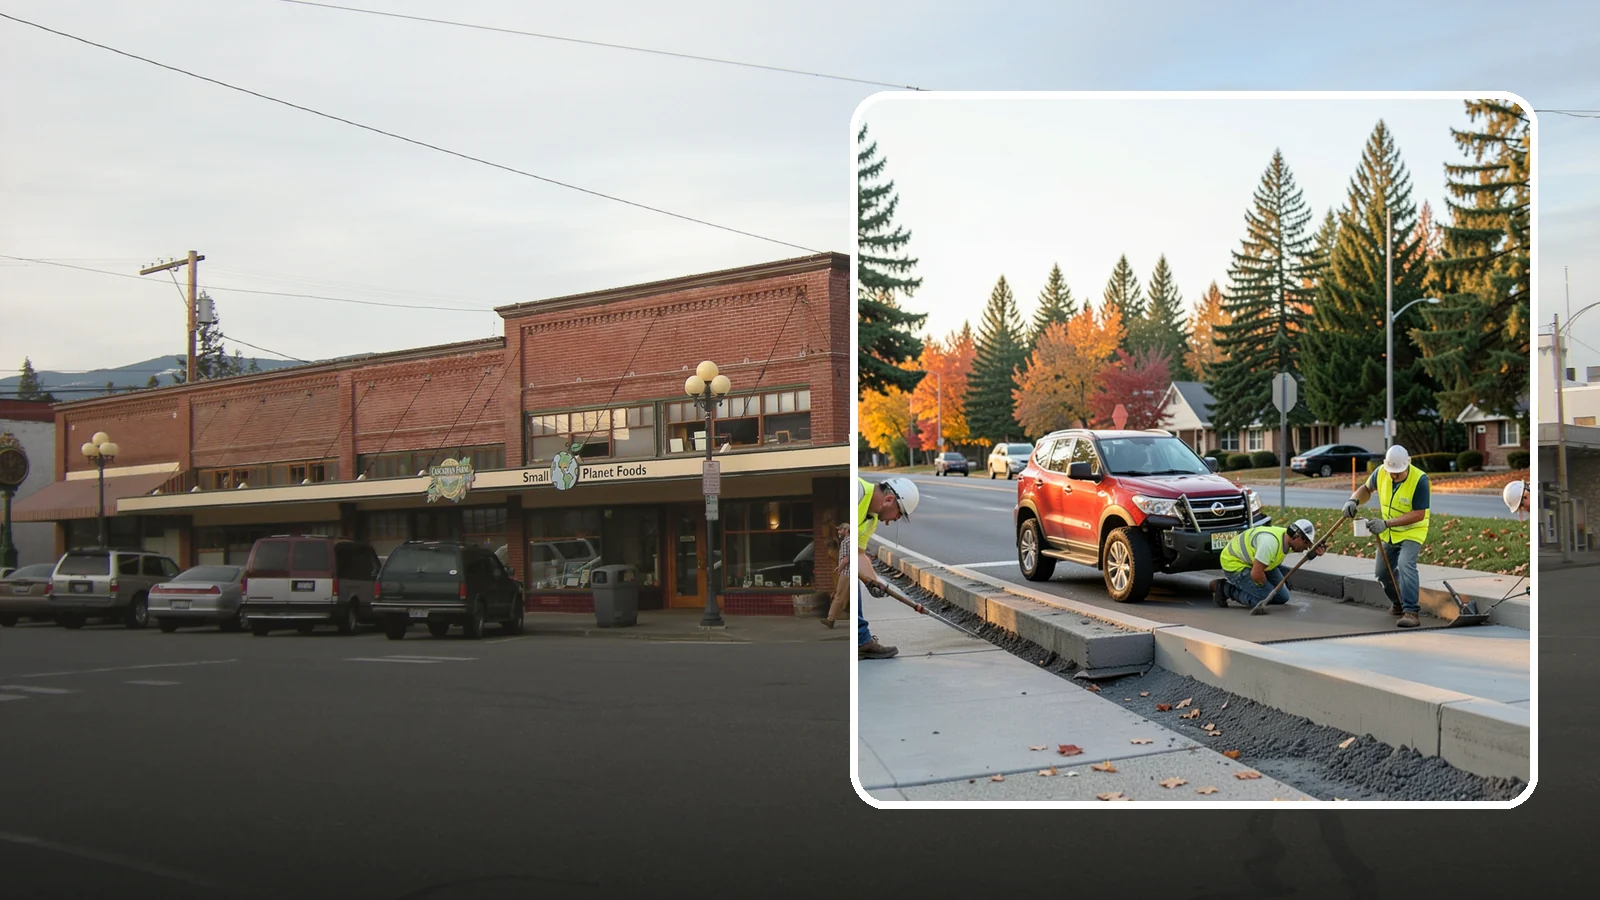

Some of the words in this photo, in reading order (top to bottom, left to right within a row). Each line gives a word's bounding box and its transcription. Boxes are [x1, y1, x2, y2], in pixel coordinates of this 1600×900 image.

[523, 471, 549, 482] Small
[582, 468, 614, 479] Planet
[617, 464, 647, 476] Foods
